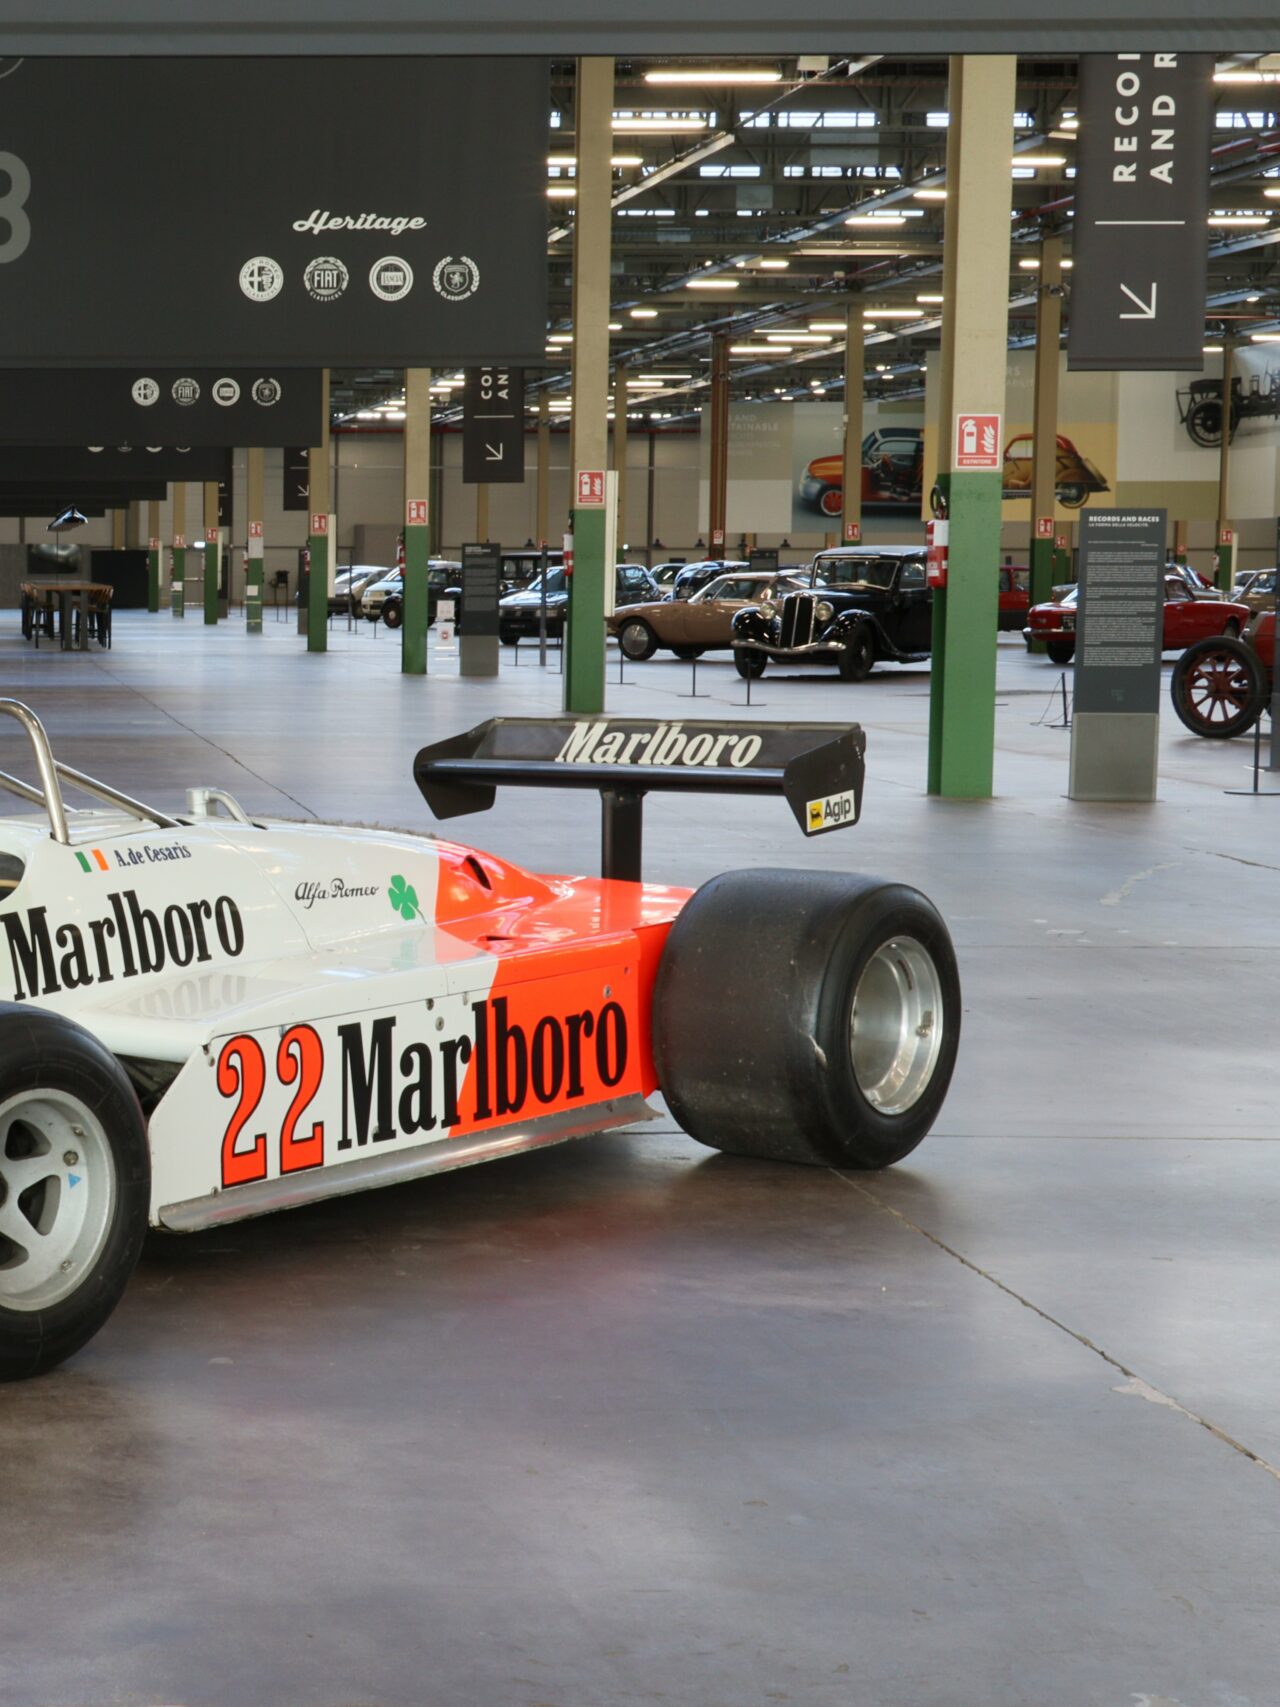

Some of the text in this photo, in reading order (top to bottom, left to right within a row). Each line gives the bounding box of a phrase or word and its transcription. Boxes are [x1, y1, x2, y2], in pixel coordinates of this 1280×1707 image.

[1113, 53, 1141, 182] RECO
[1150, 95, 1176, 184] AND
[292, 209, 427, 235] Heritage
[314, 270, 338, 288] FIAT
[481, 368, 492, 399] CO
[497, 367, 509, 399] AN
[555, 722, 762, 767] Marlboro
[823, 796, 851, 822] Agip
[144, 842, 192, 862] Cesaris
[294, 877, 379, 909] Alfa Romeo
[0, 889, 245, 1001] Marlboro
[337, 996, 628, 1151] Marlboro
[217, 1023, 324, 1189] 22
